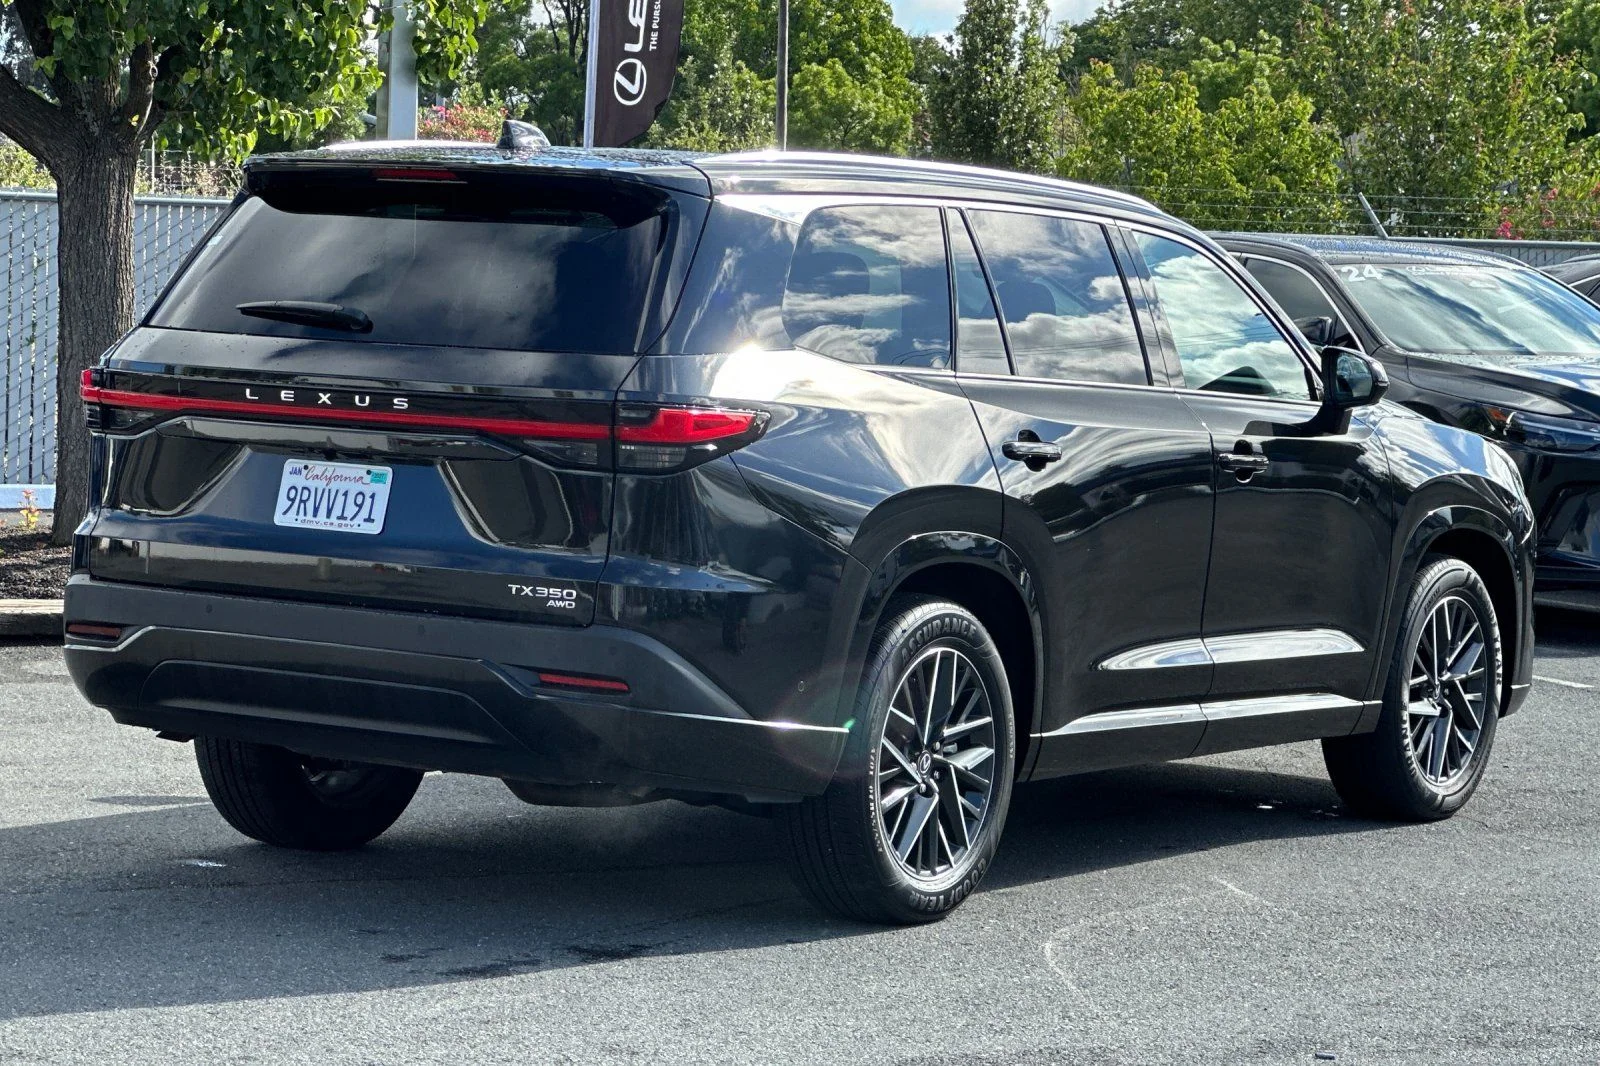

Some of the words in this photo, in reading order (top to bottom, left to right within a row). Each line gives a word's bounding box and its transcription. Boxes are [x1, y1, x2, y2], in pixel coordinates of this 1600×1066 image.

[649, 31, 659, 51] THE
[1340, 264, 1384, 282] 24
[245, 388, 409, 410] LEXUS
[289, 466, 303, 476] JAN
[305, 466, 371, 486] California
[282, 485, 377, 523] 9RVV191
[300, 518, 355, 528] dmv.ca.gov
[546, 600, 576, 609] AWD
[900, 617, 977, 662] ASSURANCE
